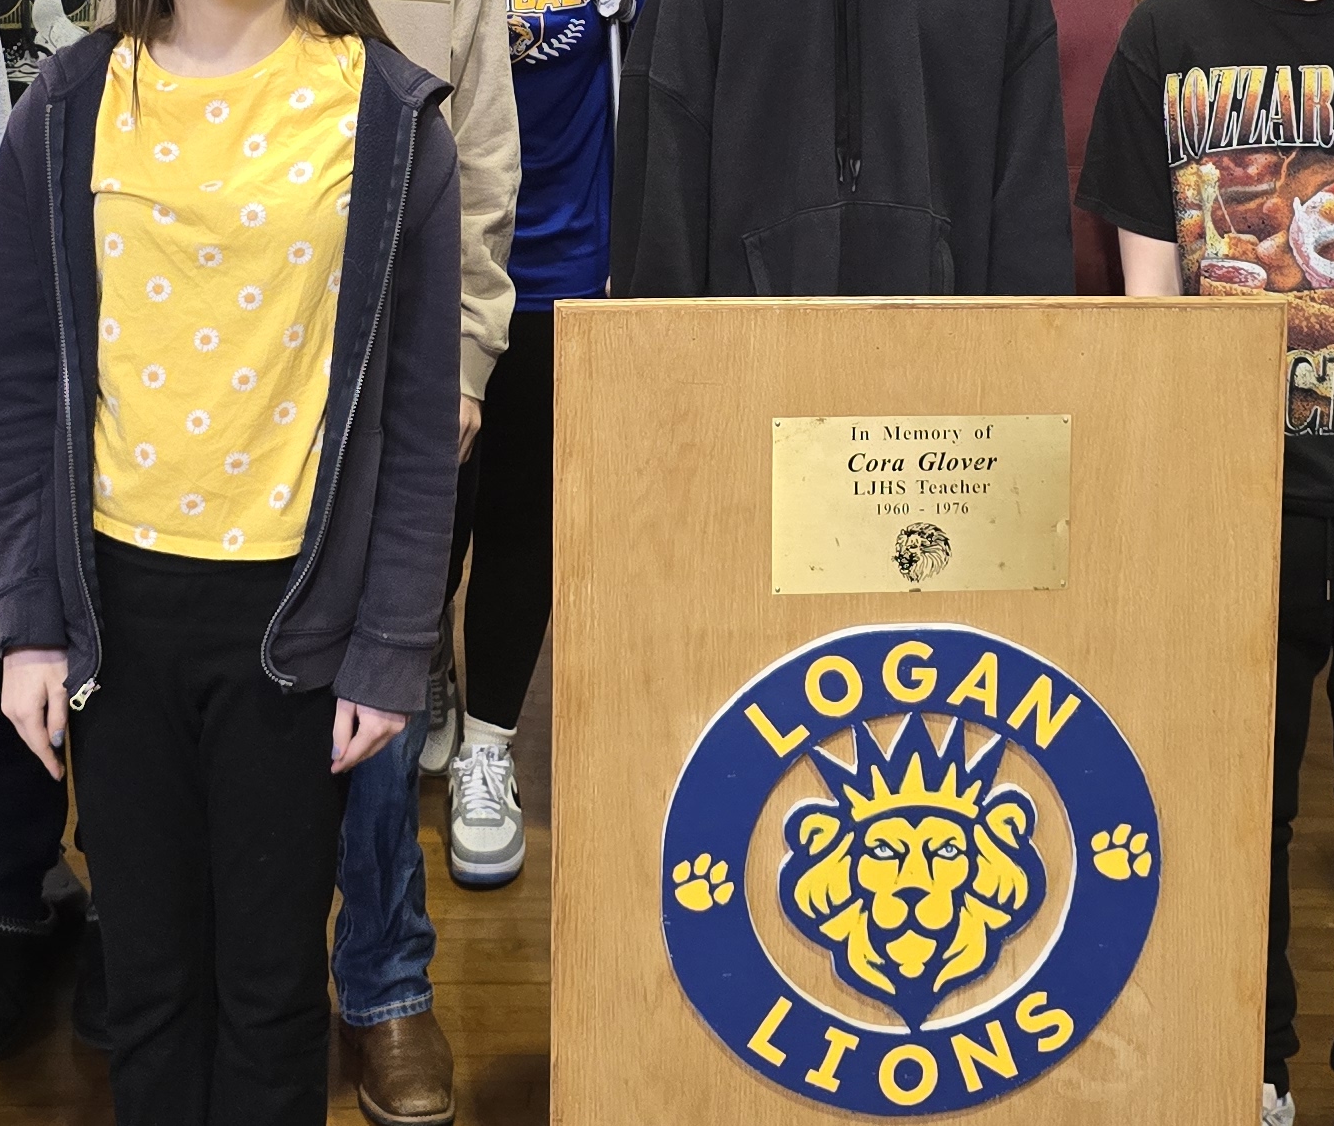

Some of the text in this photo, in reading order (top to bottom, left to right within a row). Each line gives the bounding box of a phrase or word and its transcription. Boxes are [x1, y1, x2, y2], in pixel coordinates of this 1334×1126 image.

[851, 424, 994, 446] In Memory of
[847, 451, 998, 473] Cora Glover
[853, 478, 991, 496] LJHS Teacher
[876, 502, 910, 515] 1960
[935, 501, 969, 515] 1976
[744, 640, 1082, 758] LOGAN
[747, 991, 1075, 1106] LIONS
